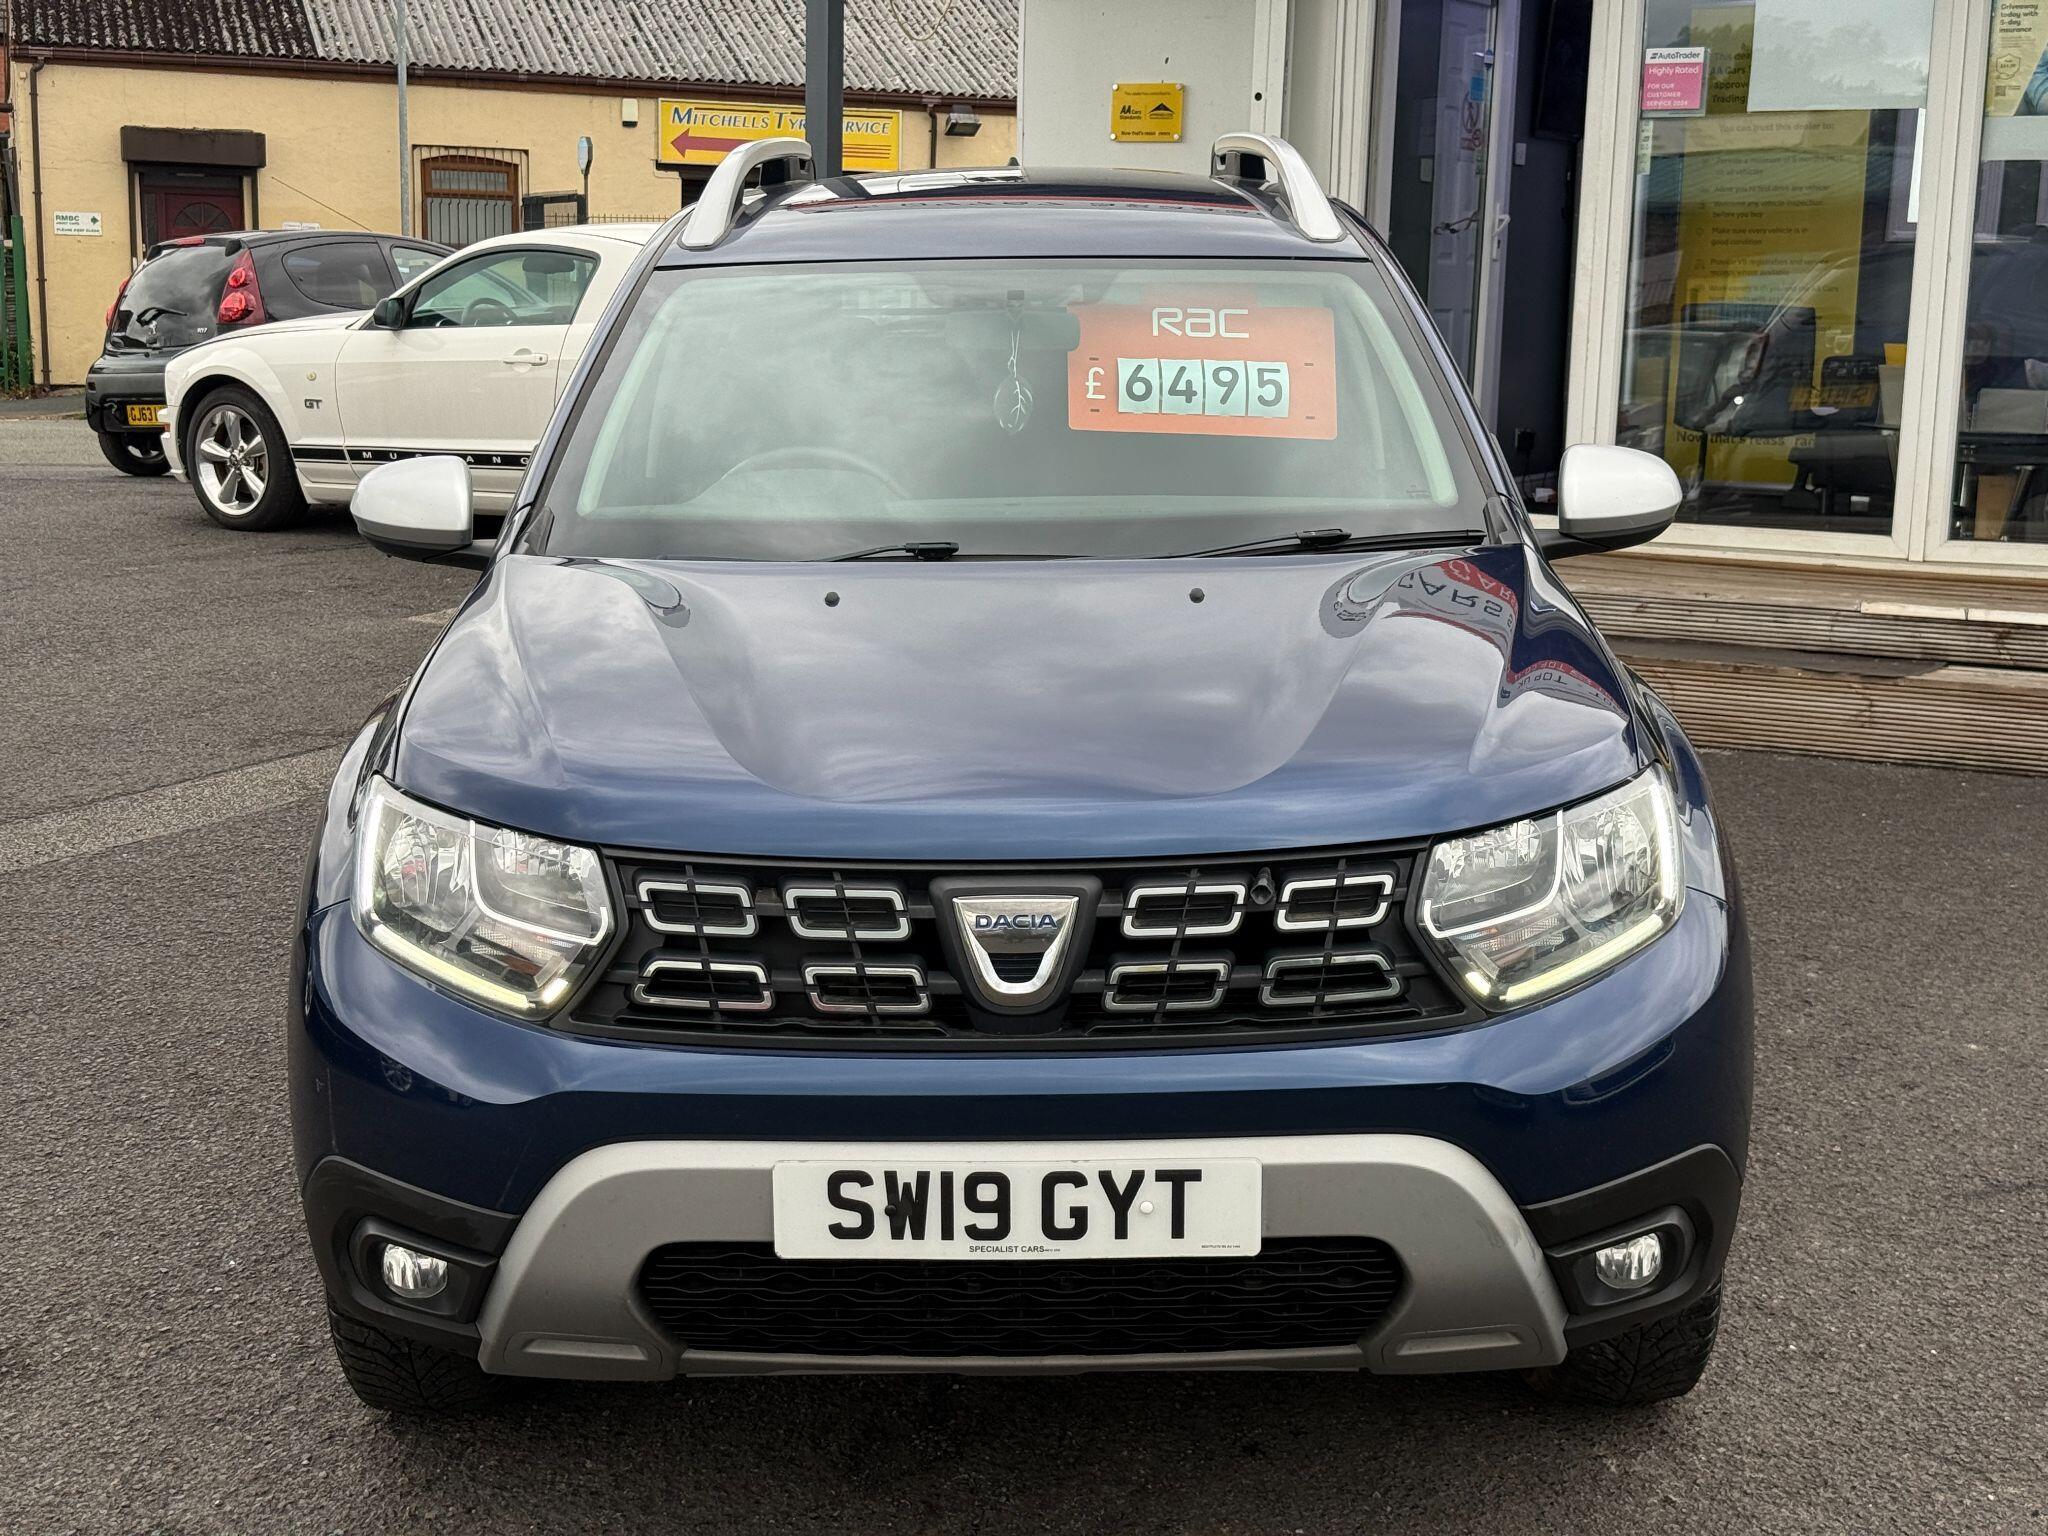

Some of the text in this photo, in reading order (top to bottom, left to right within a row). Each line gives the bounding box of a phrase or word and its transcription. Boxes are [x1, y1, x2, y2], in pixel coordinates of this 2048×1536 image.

[1657, 51, 1701, 60] AutoTrader
[1648, 66, 1698, 76] Highly Rated
[774, 111, 806, 130] TYR
[845, 121, 891, 134] RVICE
[304, 398, 323, 409] GT
[975, 914, 1058, 929] DACIA
[827, 1169, 1203, 1241] SW19 GYT
[969, 1245, 1019, 1253] SPECIALIST
[1020, 1245, 1045, 1253] CARS
